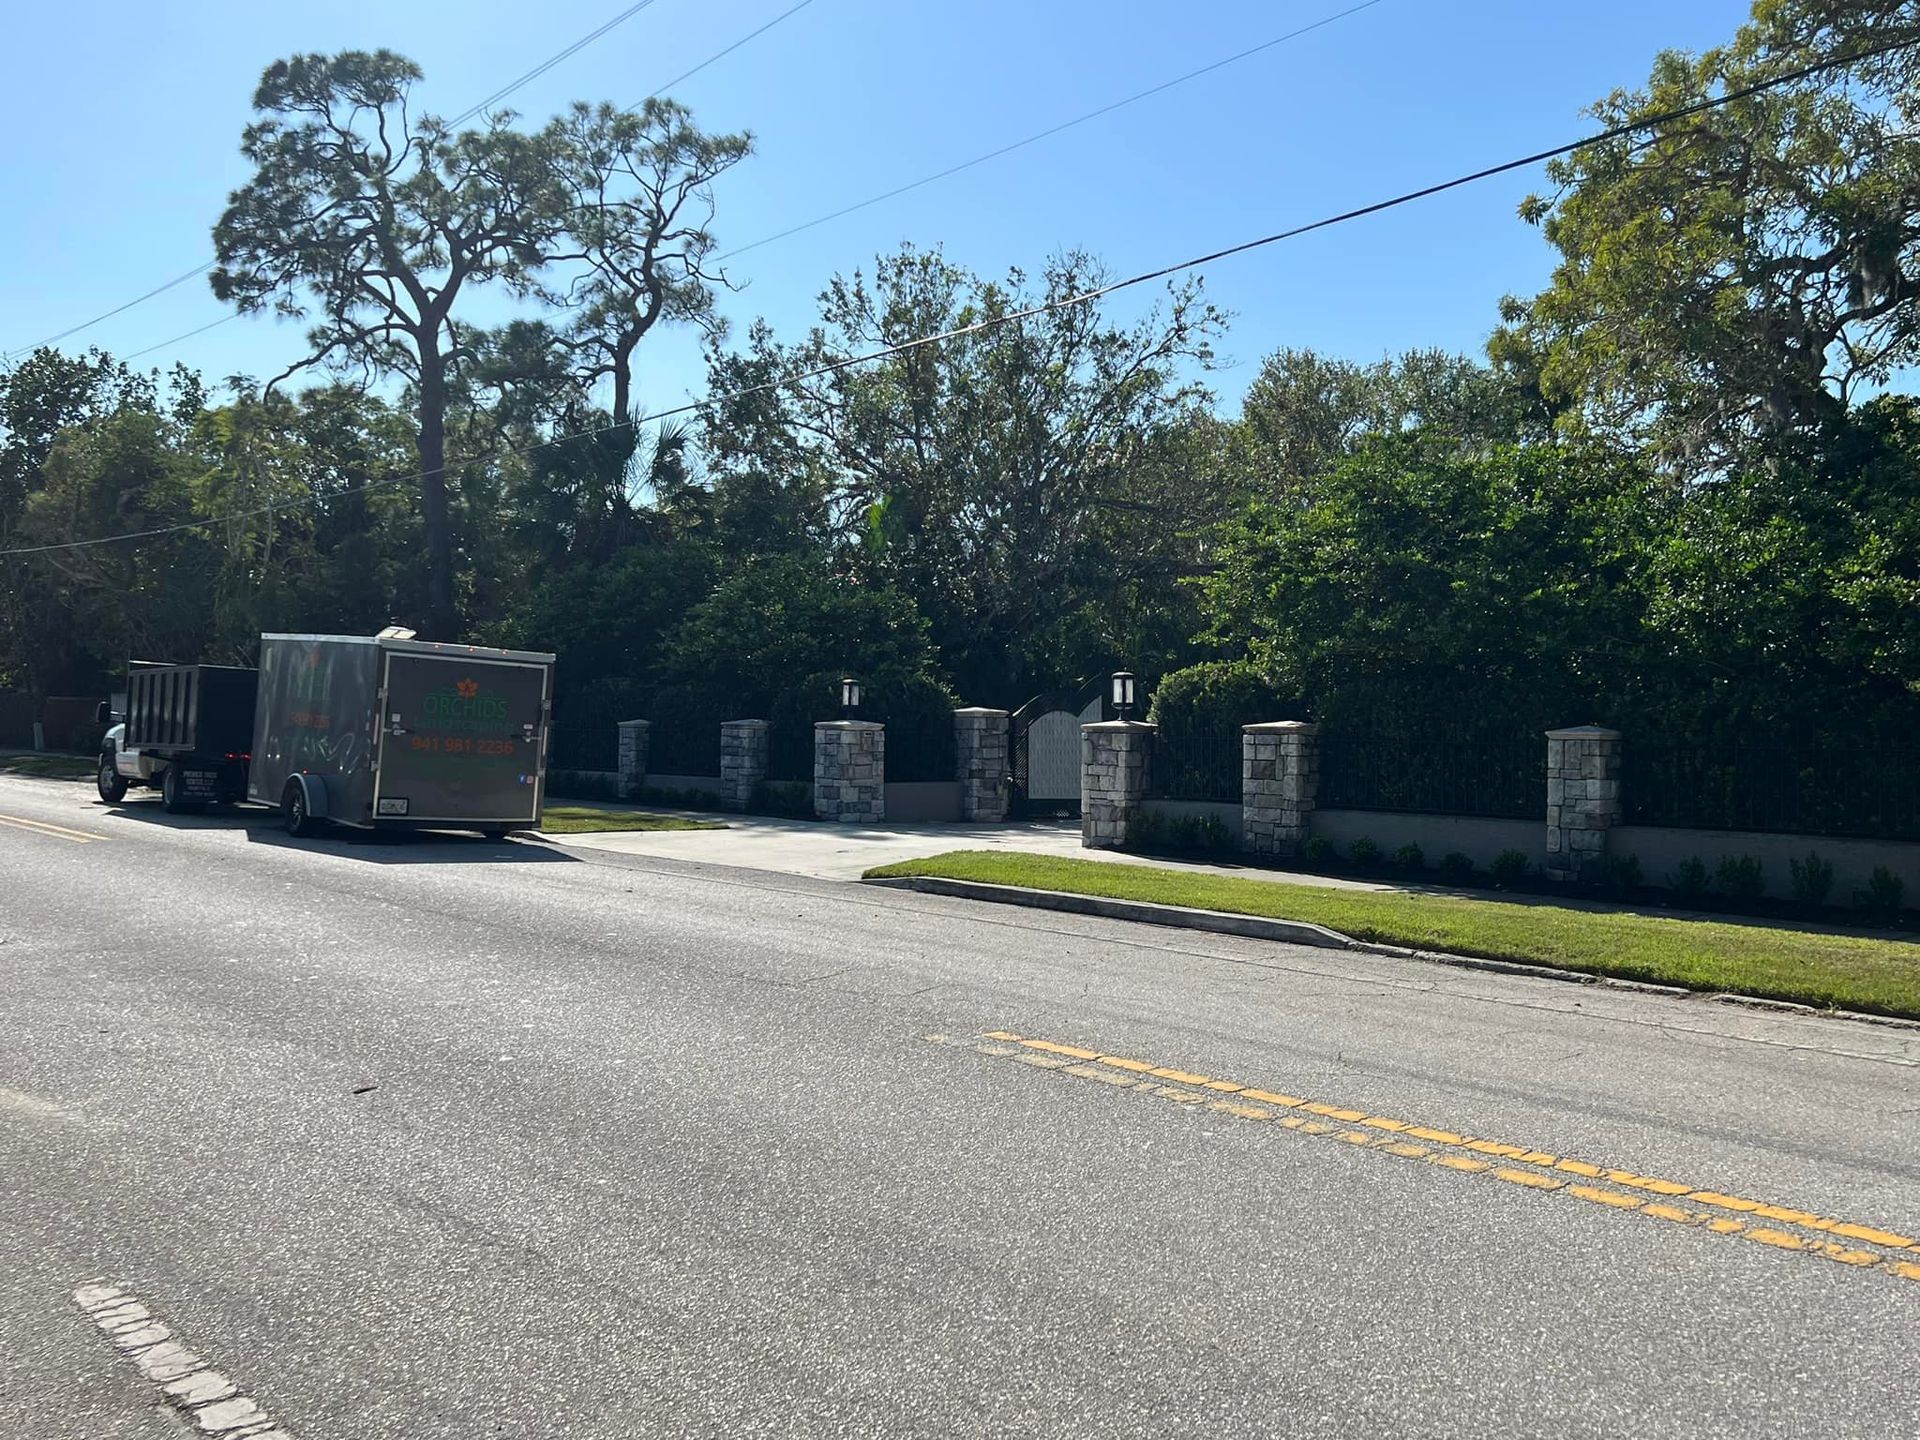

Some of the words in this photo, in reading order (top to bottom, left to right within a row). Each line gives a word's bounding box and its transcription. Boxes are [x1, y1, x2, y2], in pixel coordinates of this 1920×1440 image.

[423, 695, 512, 718] ORCHIDS
[411, 735, 438, 752] 941
[477, 738, 513, 755] 2236
